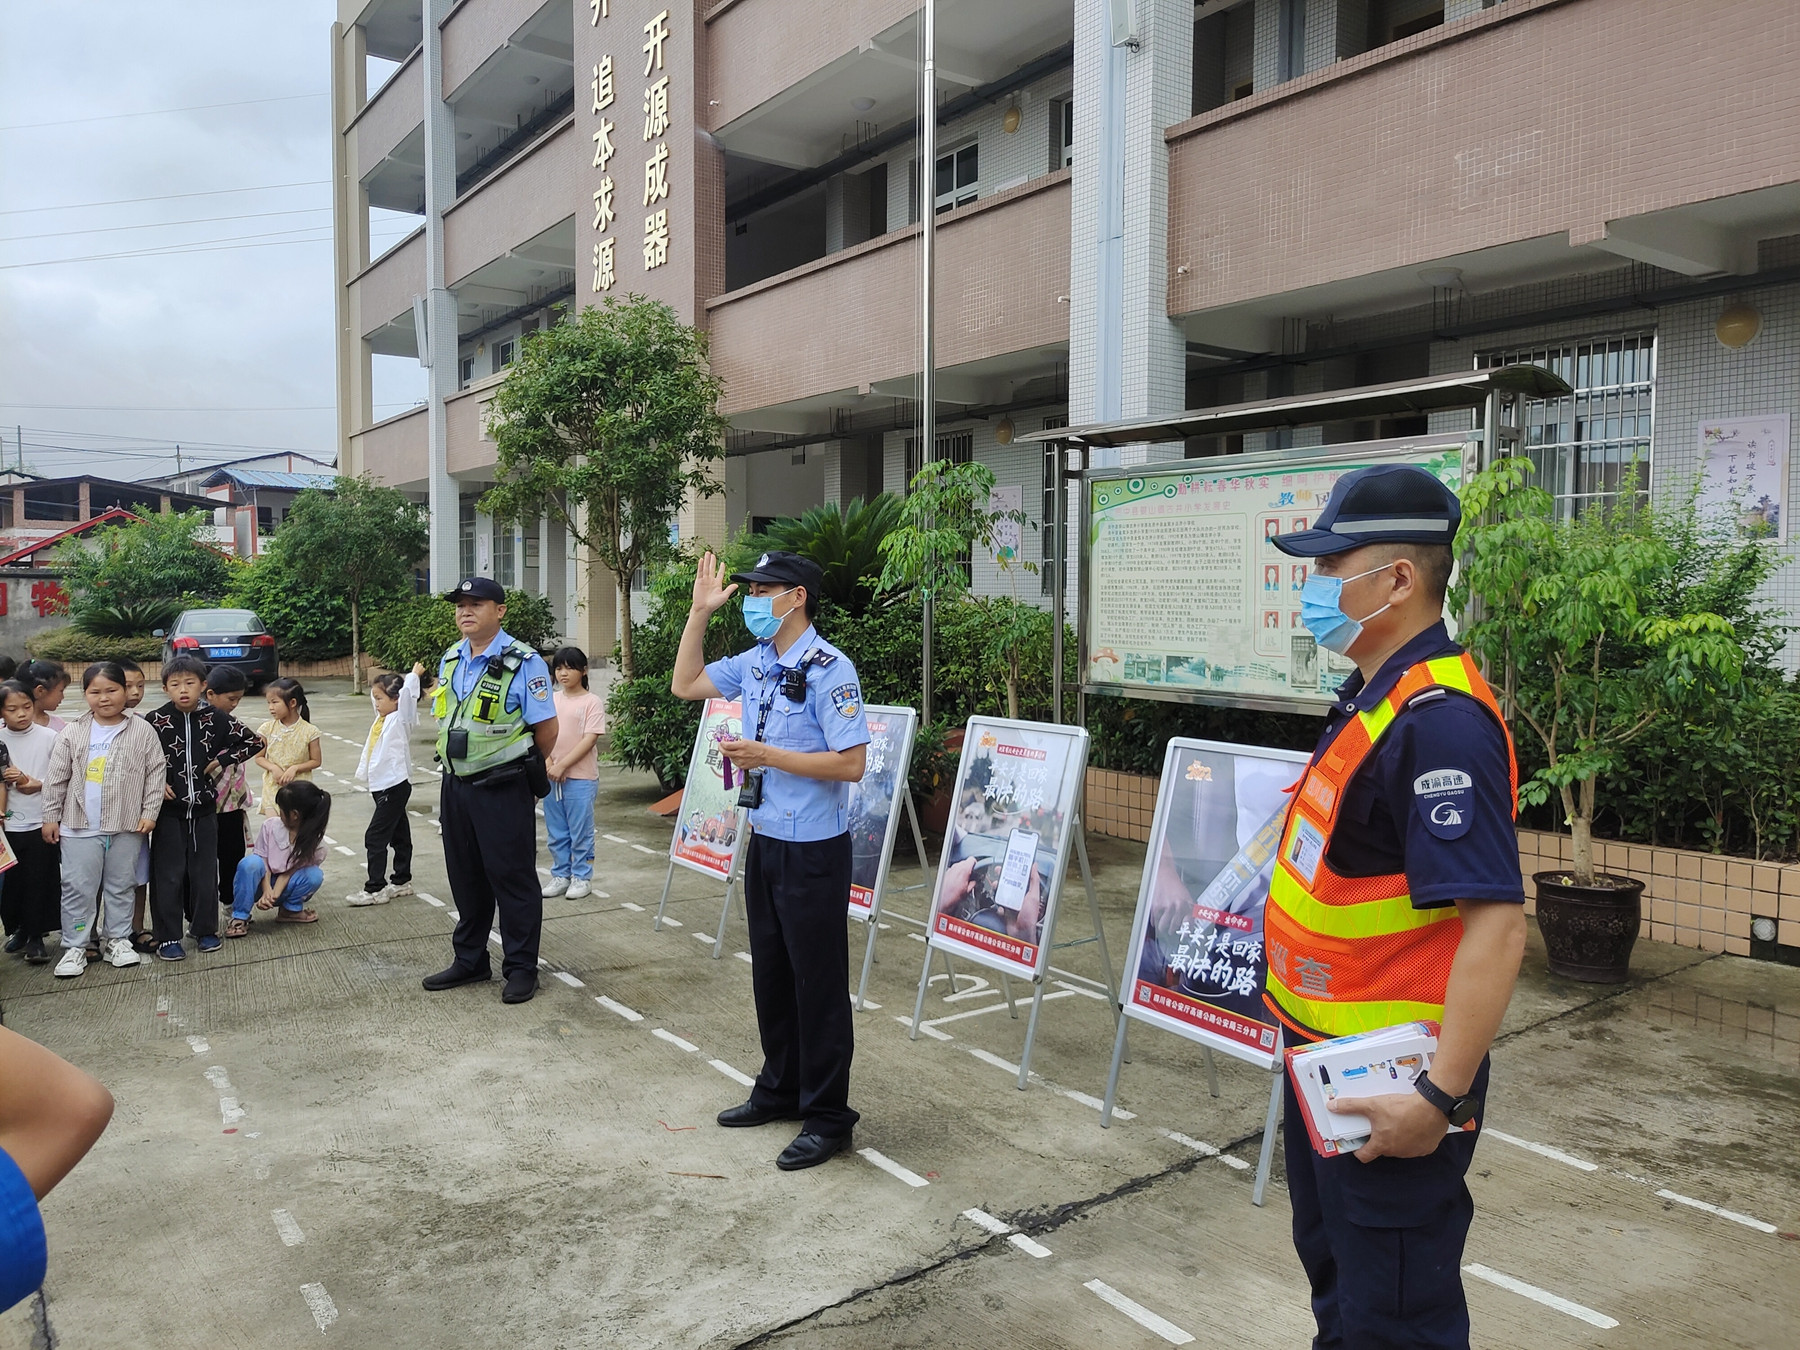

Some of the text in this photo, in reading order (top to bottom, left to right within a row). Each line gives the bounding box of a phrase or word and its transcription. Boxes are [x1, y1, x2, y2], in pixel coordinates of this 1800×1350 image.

[642, 9, 670, 272] 开源成器
[590, 54, 616, 293] 追本求源
[1727, 454, 1738, 501] 下笔如有
[982, 776, 1044, 810] 最快的路
[988, 758, 1049, 785] 平安才是回家
[1420, 774, 1464, 791] 成渝高速
[1175, 921, 1263, 964] 平安才是回家
[1167, 944, 1258, 997] 最快的路
[1270, 937, 1334, 999] 巡查
[1152, 993, 1258, 1039] 四川省公安厅高速公路公安局三分局
